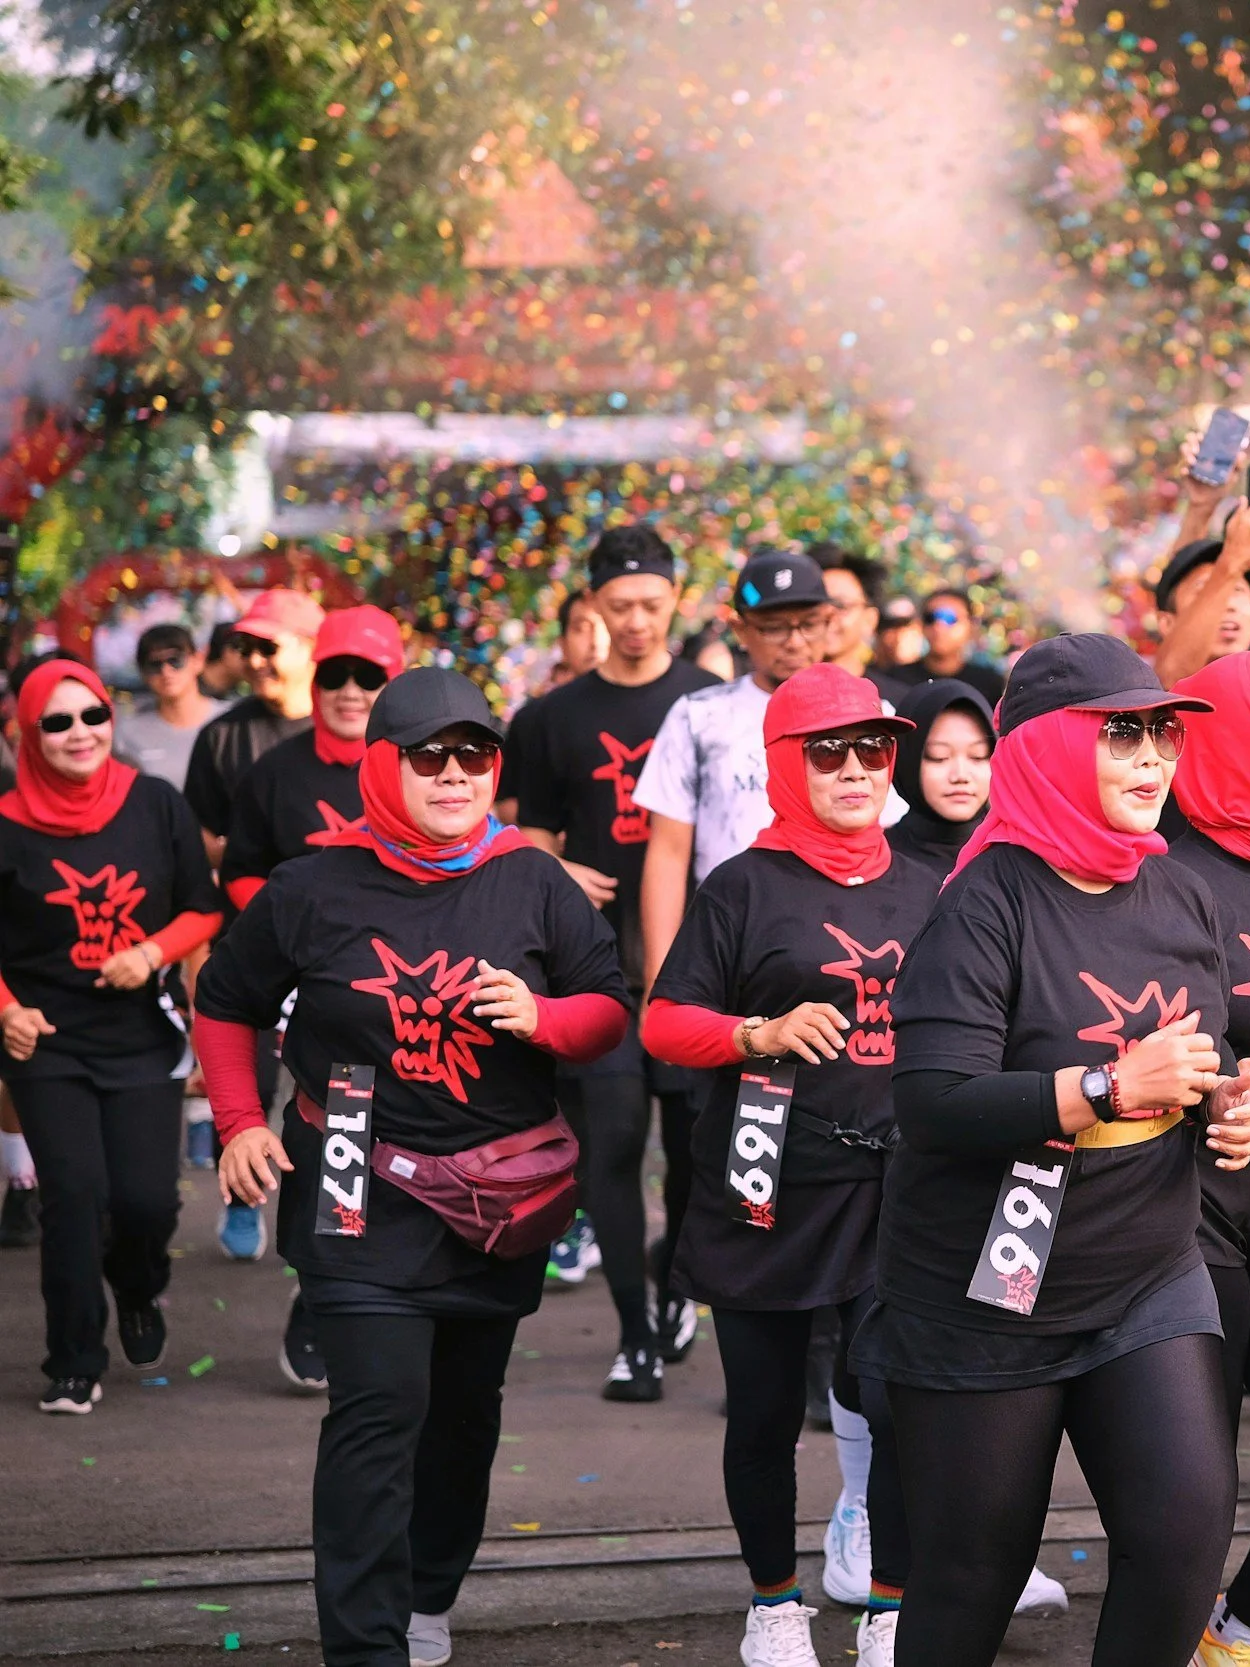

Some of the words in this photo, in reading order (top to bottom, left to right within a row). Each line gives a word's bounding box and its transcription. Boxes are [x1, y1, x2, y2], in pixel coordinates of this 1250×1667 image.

[323, 1111, 366, 1210] 167
[730, 1104, 784, 1205] 169
[990, 1161, 1064, 1275] 166
